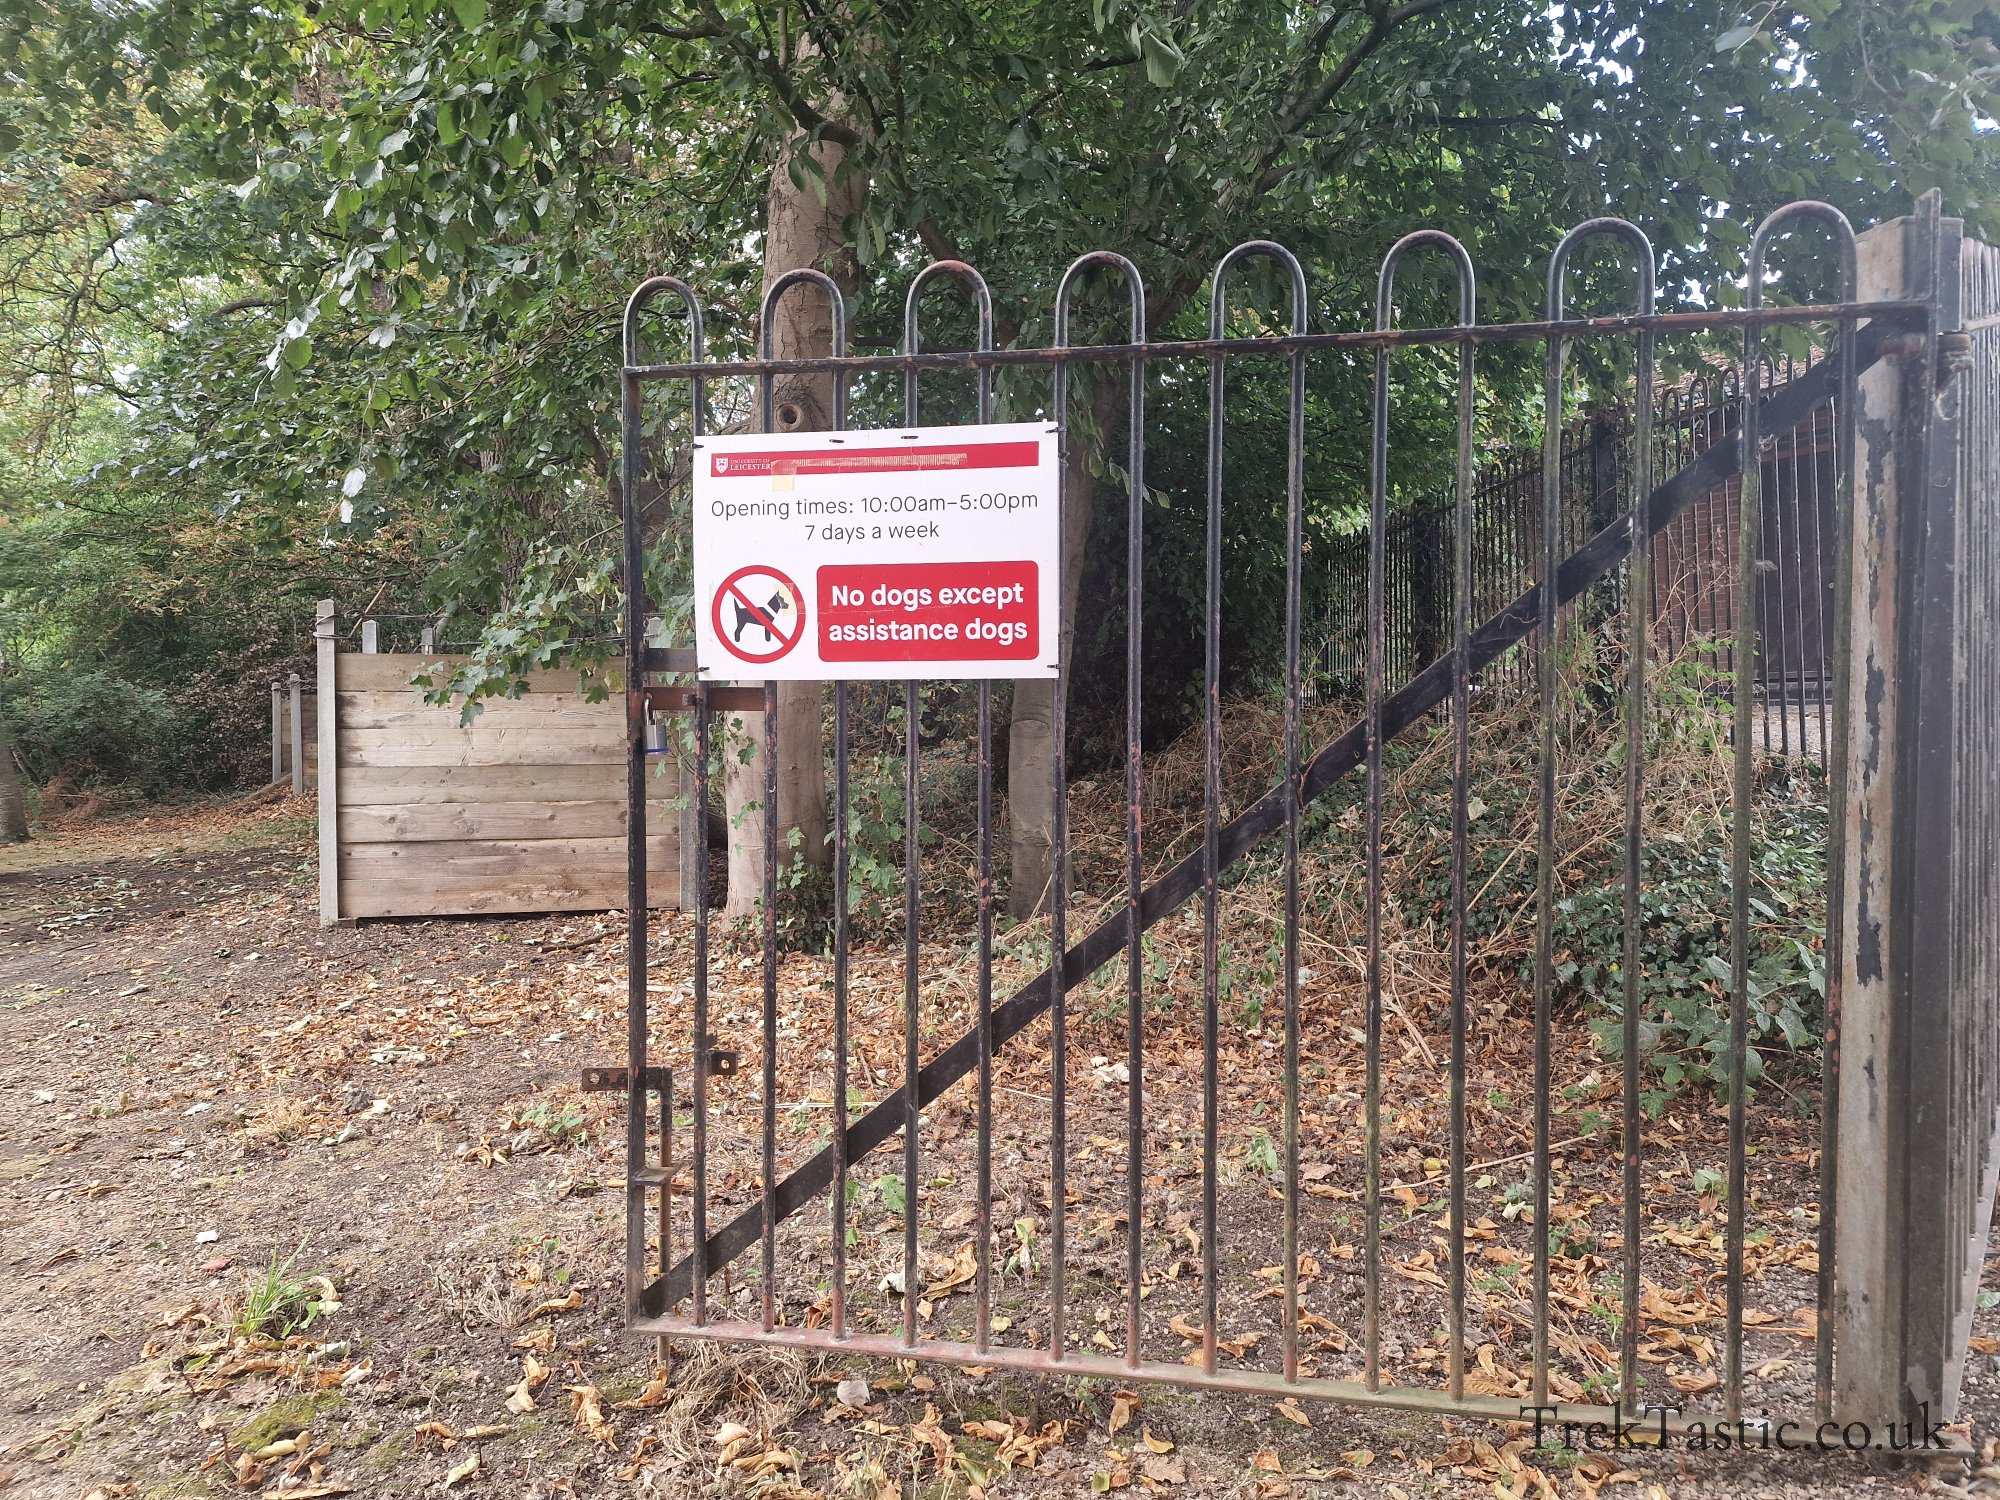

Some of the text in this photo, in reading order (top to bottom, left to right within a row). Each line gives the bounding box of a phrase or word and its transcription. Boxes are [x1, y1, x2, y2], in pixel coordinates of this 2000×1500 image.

[711, 498, 790, 520] Opening
[797, 497, 854, 515] times:
[805, 522, 939, 544] 7 days a week
[831, 582, 1024, 611] No dogs except
[829, 618, 1027, 645] assistance dogs
